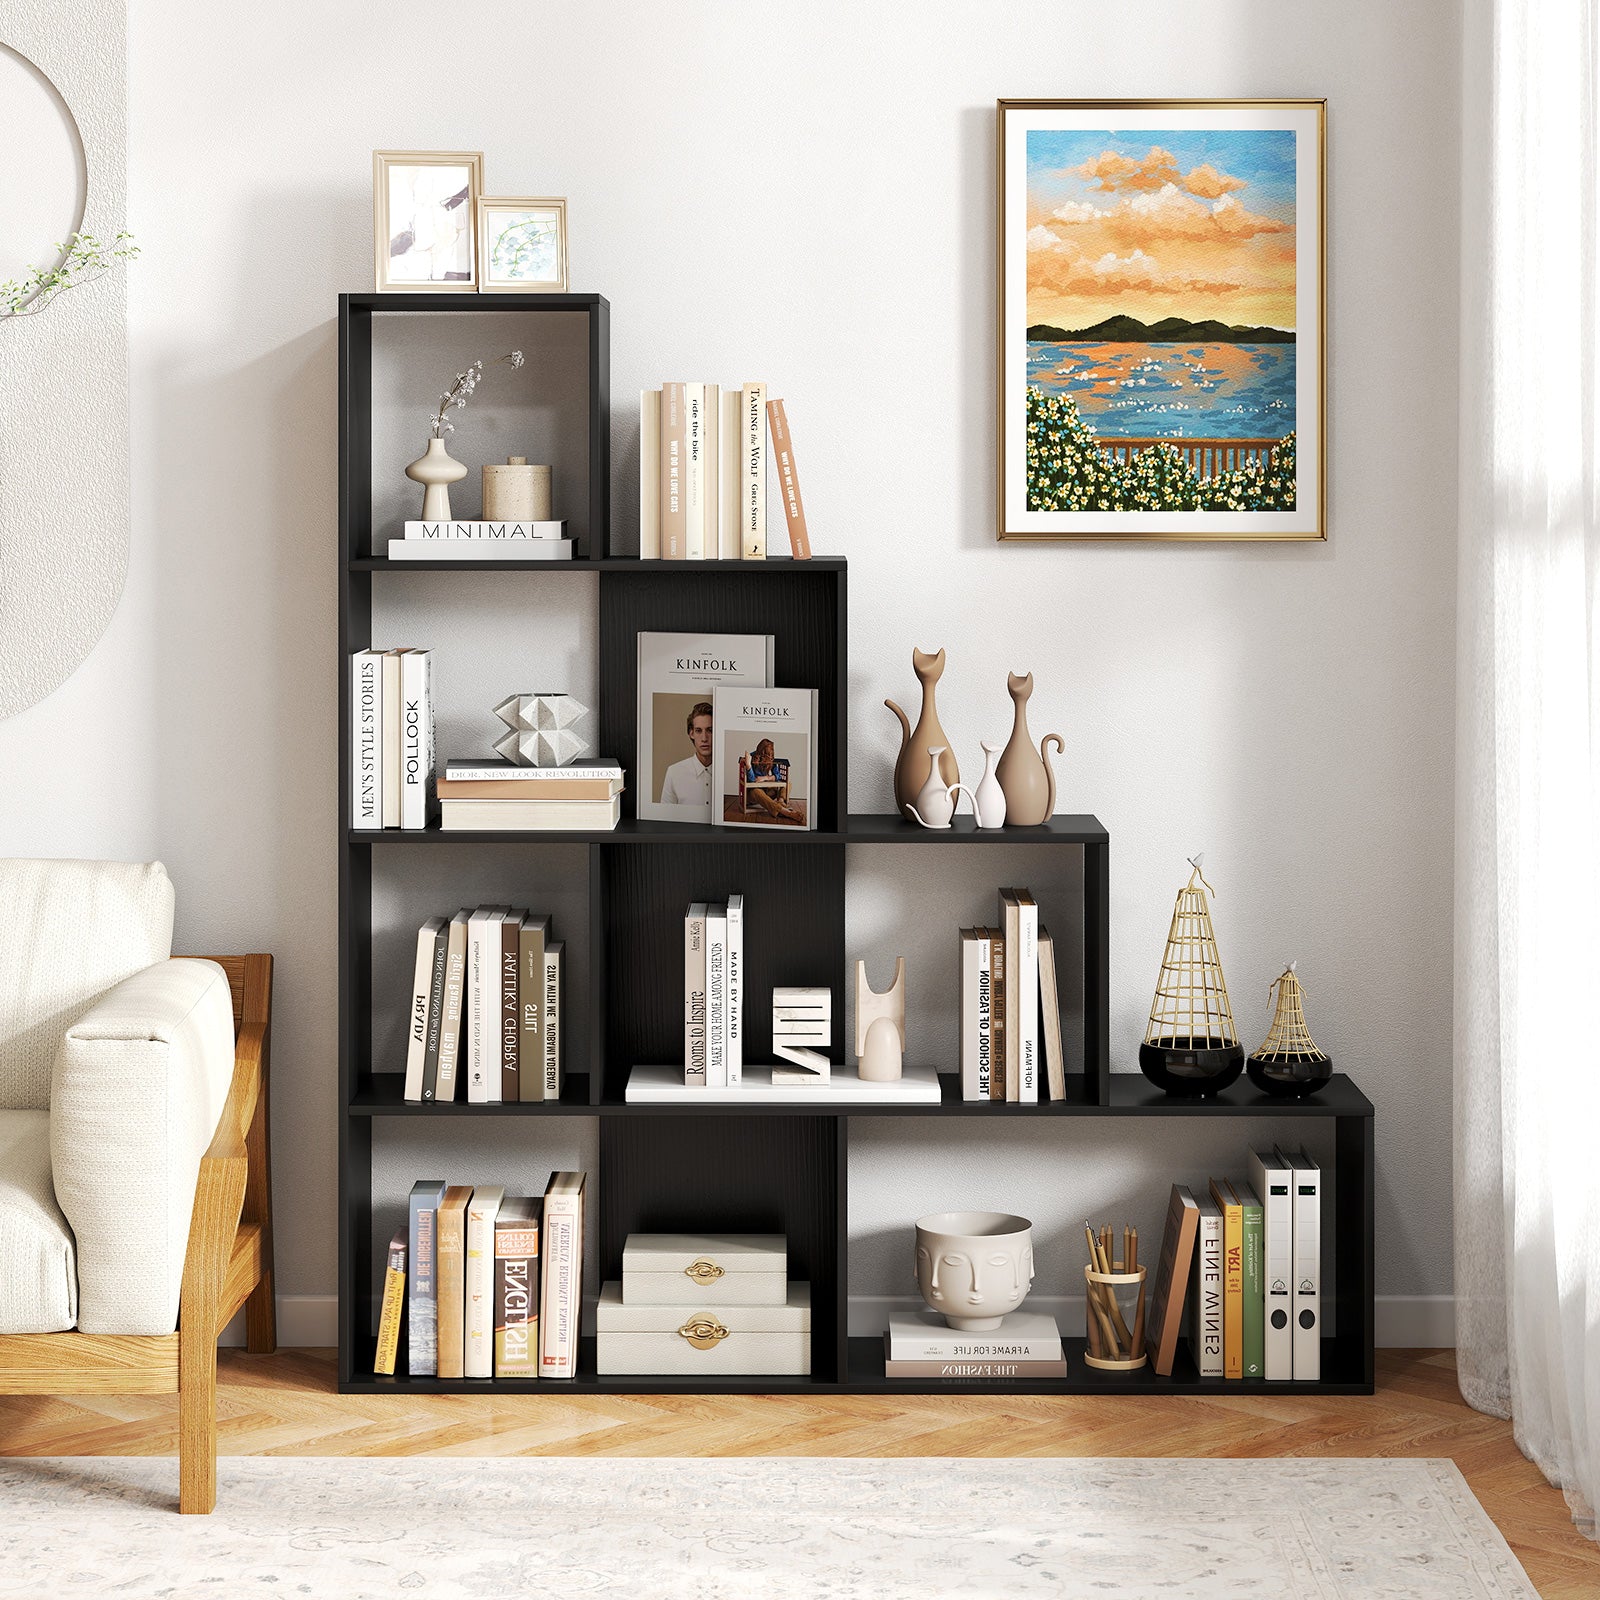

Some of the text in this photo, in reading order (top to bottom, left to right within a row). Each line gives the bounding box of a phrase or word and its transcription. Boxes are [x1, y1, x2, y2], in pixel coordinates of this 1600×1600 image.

[751, 389, 760, 431] TAMING
[671, 457, 678, 466] DO
[671, 467, 678, 477] WE
[751, 447, 759, 477] WOLF
[781, 451, 798, 518] WHY DO WE LOVE CATS
[423, 522, 542, 540] MINIMAL
[677, 658, 737, 671] KINFOLK
[743, 707, 789, 716] KINFOLK
[361, 663, 374, 817] MEN'S STYLE STORIES
[407, 700, 418, 784] POLLOCK
[690, 921, 702, 951] Annie Kelly
[711, 943, 722, 1066] MAKE YOUR HOME AMONG FRIENDS
[731, 989, 737, 1002] BY
[686, 991, 706, 1075] Rooms to Inspire
